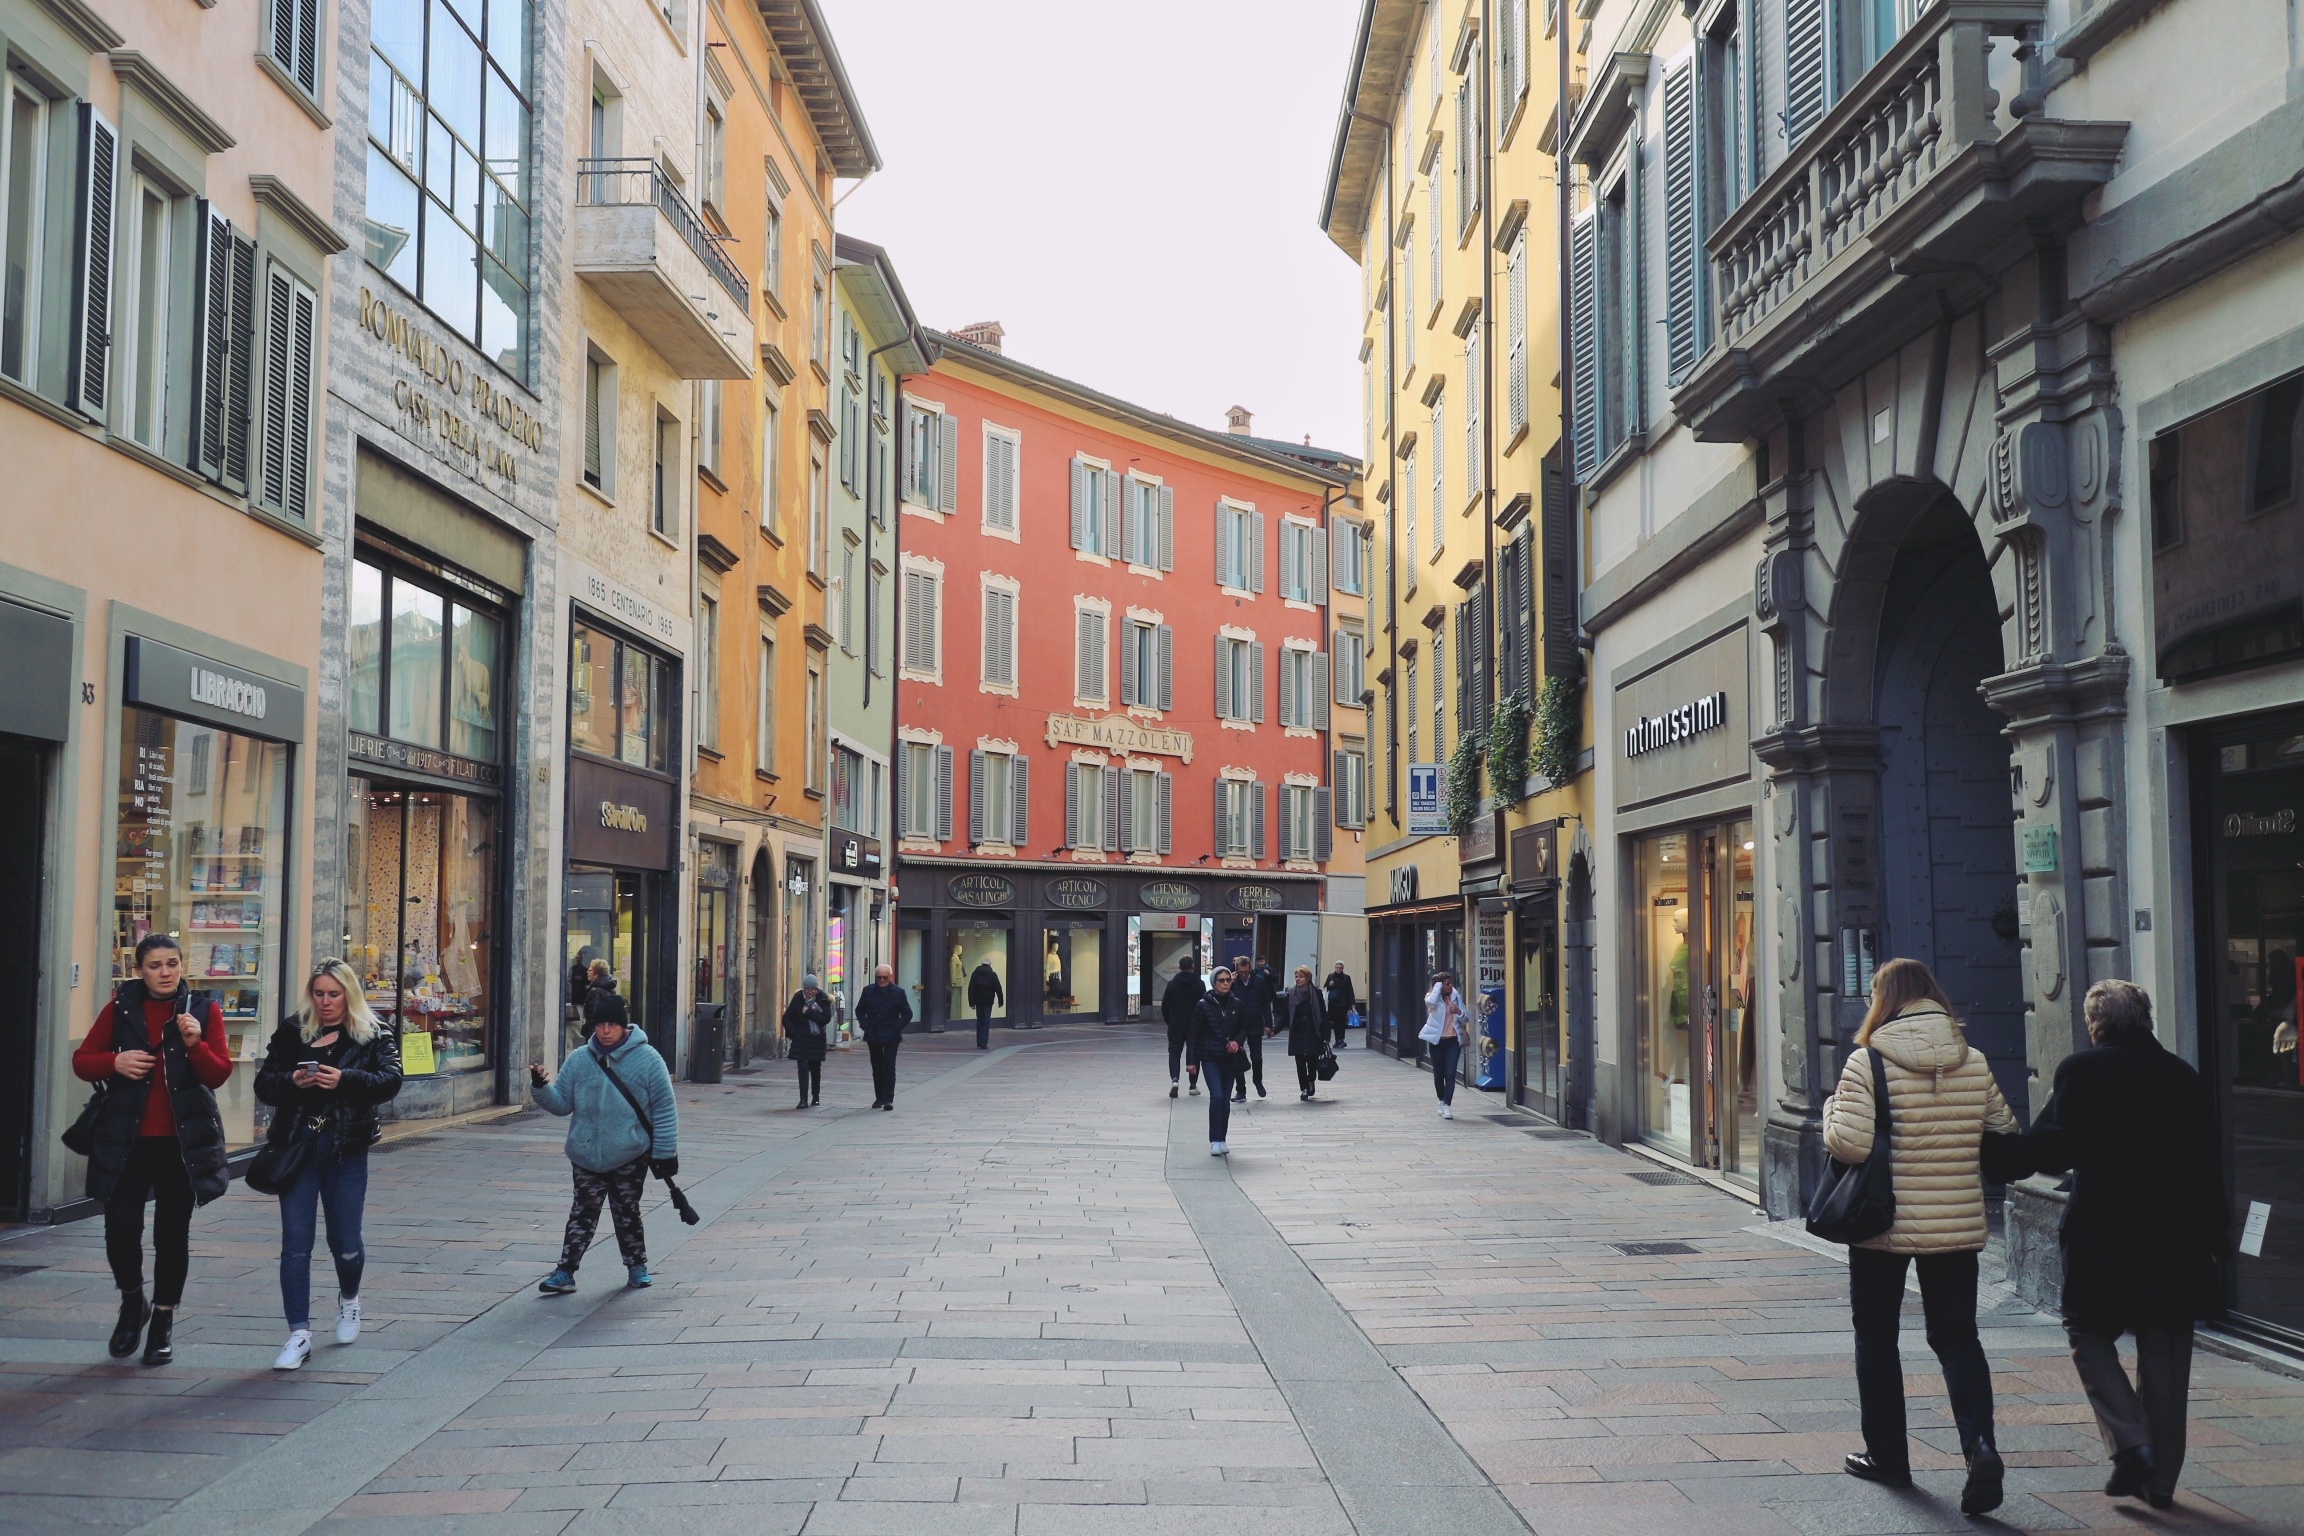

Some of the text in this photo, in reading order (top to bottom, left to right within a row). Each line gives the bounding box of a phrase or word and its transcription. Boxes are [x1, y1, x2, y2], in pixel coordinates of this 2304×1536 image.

[359, 286, 544, 454] ROMVALDO PRADERIO
[394, 379, 518, 485] CASA DELLA LANA
[587, 576, 673, 637] 1865 CENTENARIO 1965
[190, 666, 267, 719] LIBRACCIO
[1624, 691, 1724, 758] intimissimi
[1093, 725, 1188, 752] MAZZOLENI
[139, 746, 146, 759] RI
[139, 763, 145, 775] TI
[406, 751, 416, 766] dal
[416, 752, 432, 769] 1917
[450, 757, 478, 779] FILATI
[134, 779, 145, 792] RIA
[134, 796, 144, 808] MO
[961, 876, 1005, 890] ARTICOLI
[1057, 880, 1097, 893] ARTICOLI
[1153, 883, 1189, 895] UTENSILI
[957, 890, 1009, 904] CASALINGHI
[1239, 886, 1271, 898] FERRI E
[1061, 894, 1094, 906] TECNICI
[1150, 896, 1192, 908] MECCANICI
[1237, 898, 1272, 910] METALLI
